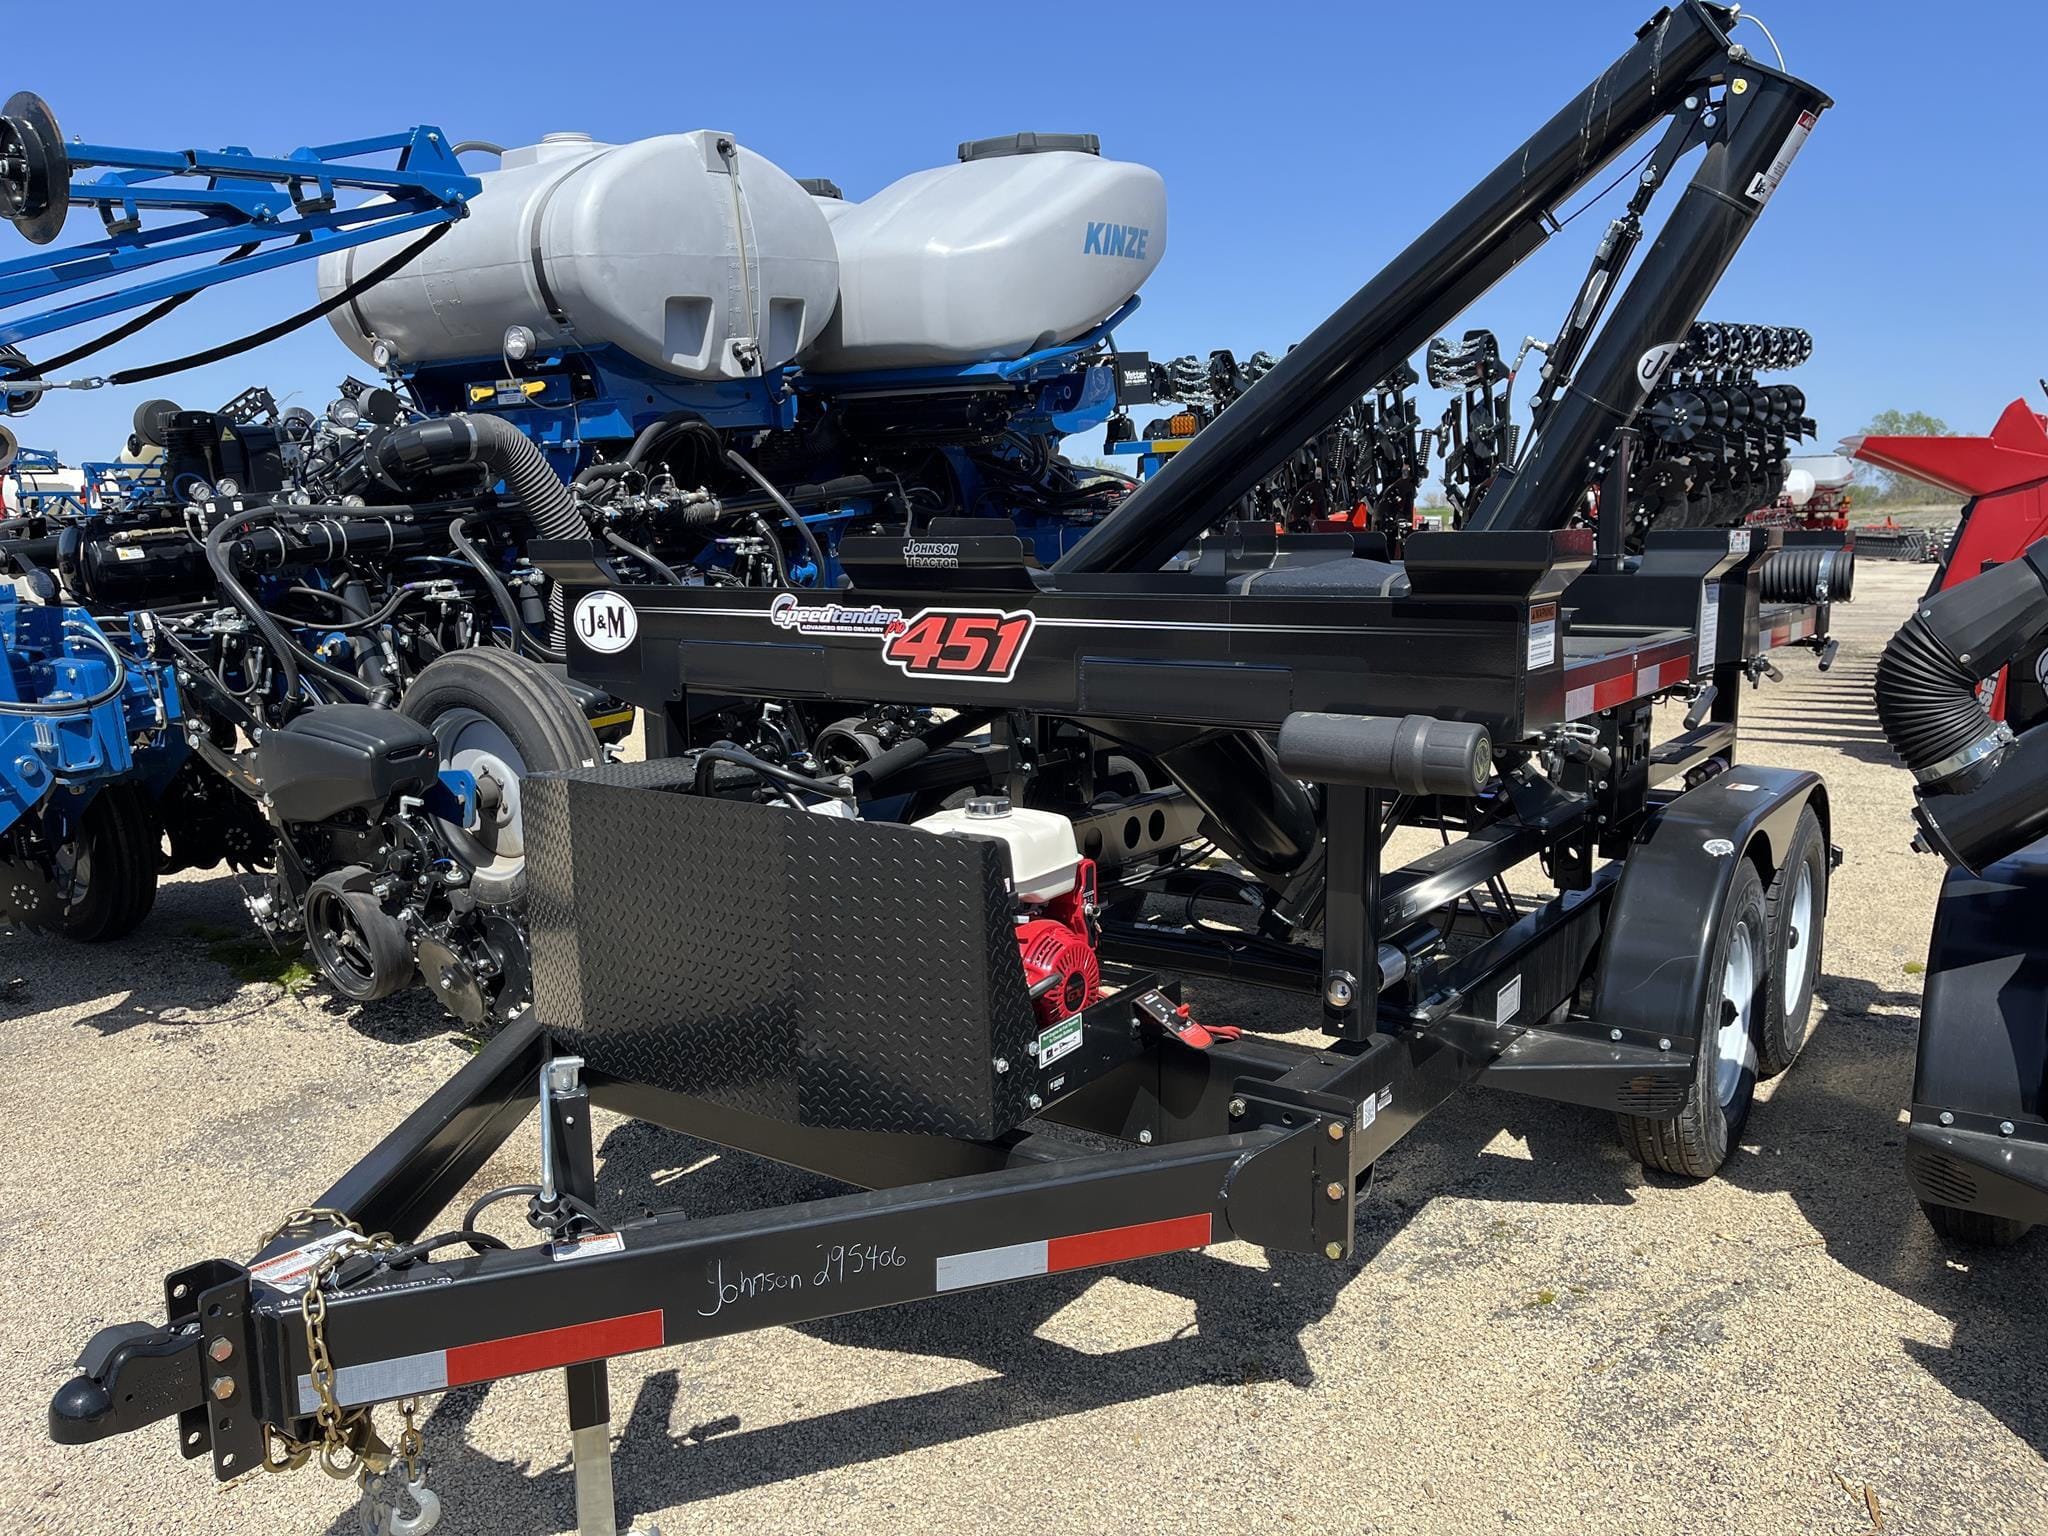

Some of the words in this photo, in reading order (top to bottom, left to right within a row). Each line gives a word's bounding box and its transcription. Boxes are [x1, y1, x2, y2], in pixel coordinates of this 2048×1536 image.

[1083, 222, 1149, 260] KINZE
[903, 539, 959, 556] JOHNSON
[904, 553, 959, 568] TRACTOR
[581, 606, 627, 638] J&M
[801, 624, 836, 632] ADVANCED
[890, 616, 1028, 673] 451
